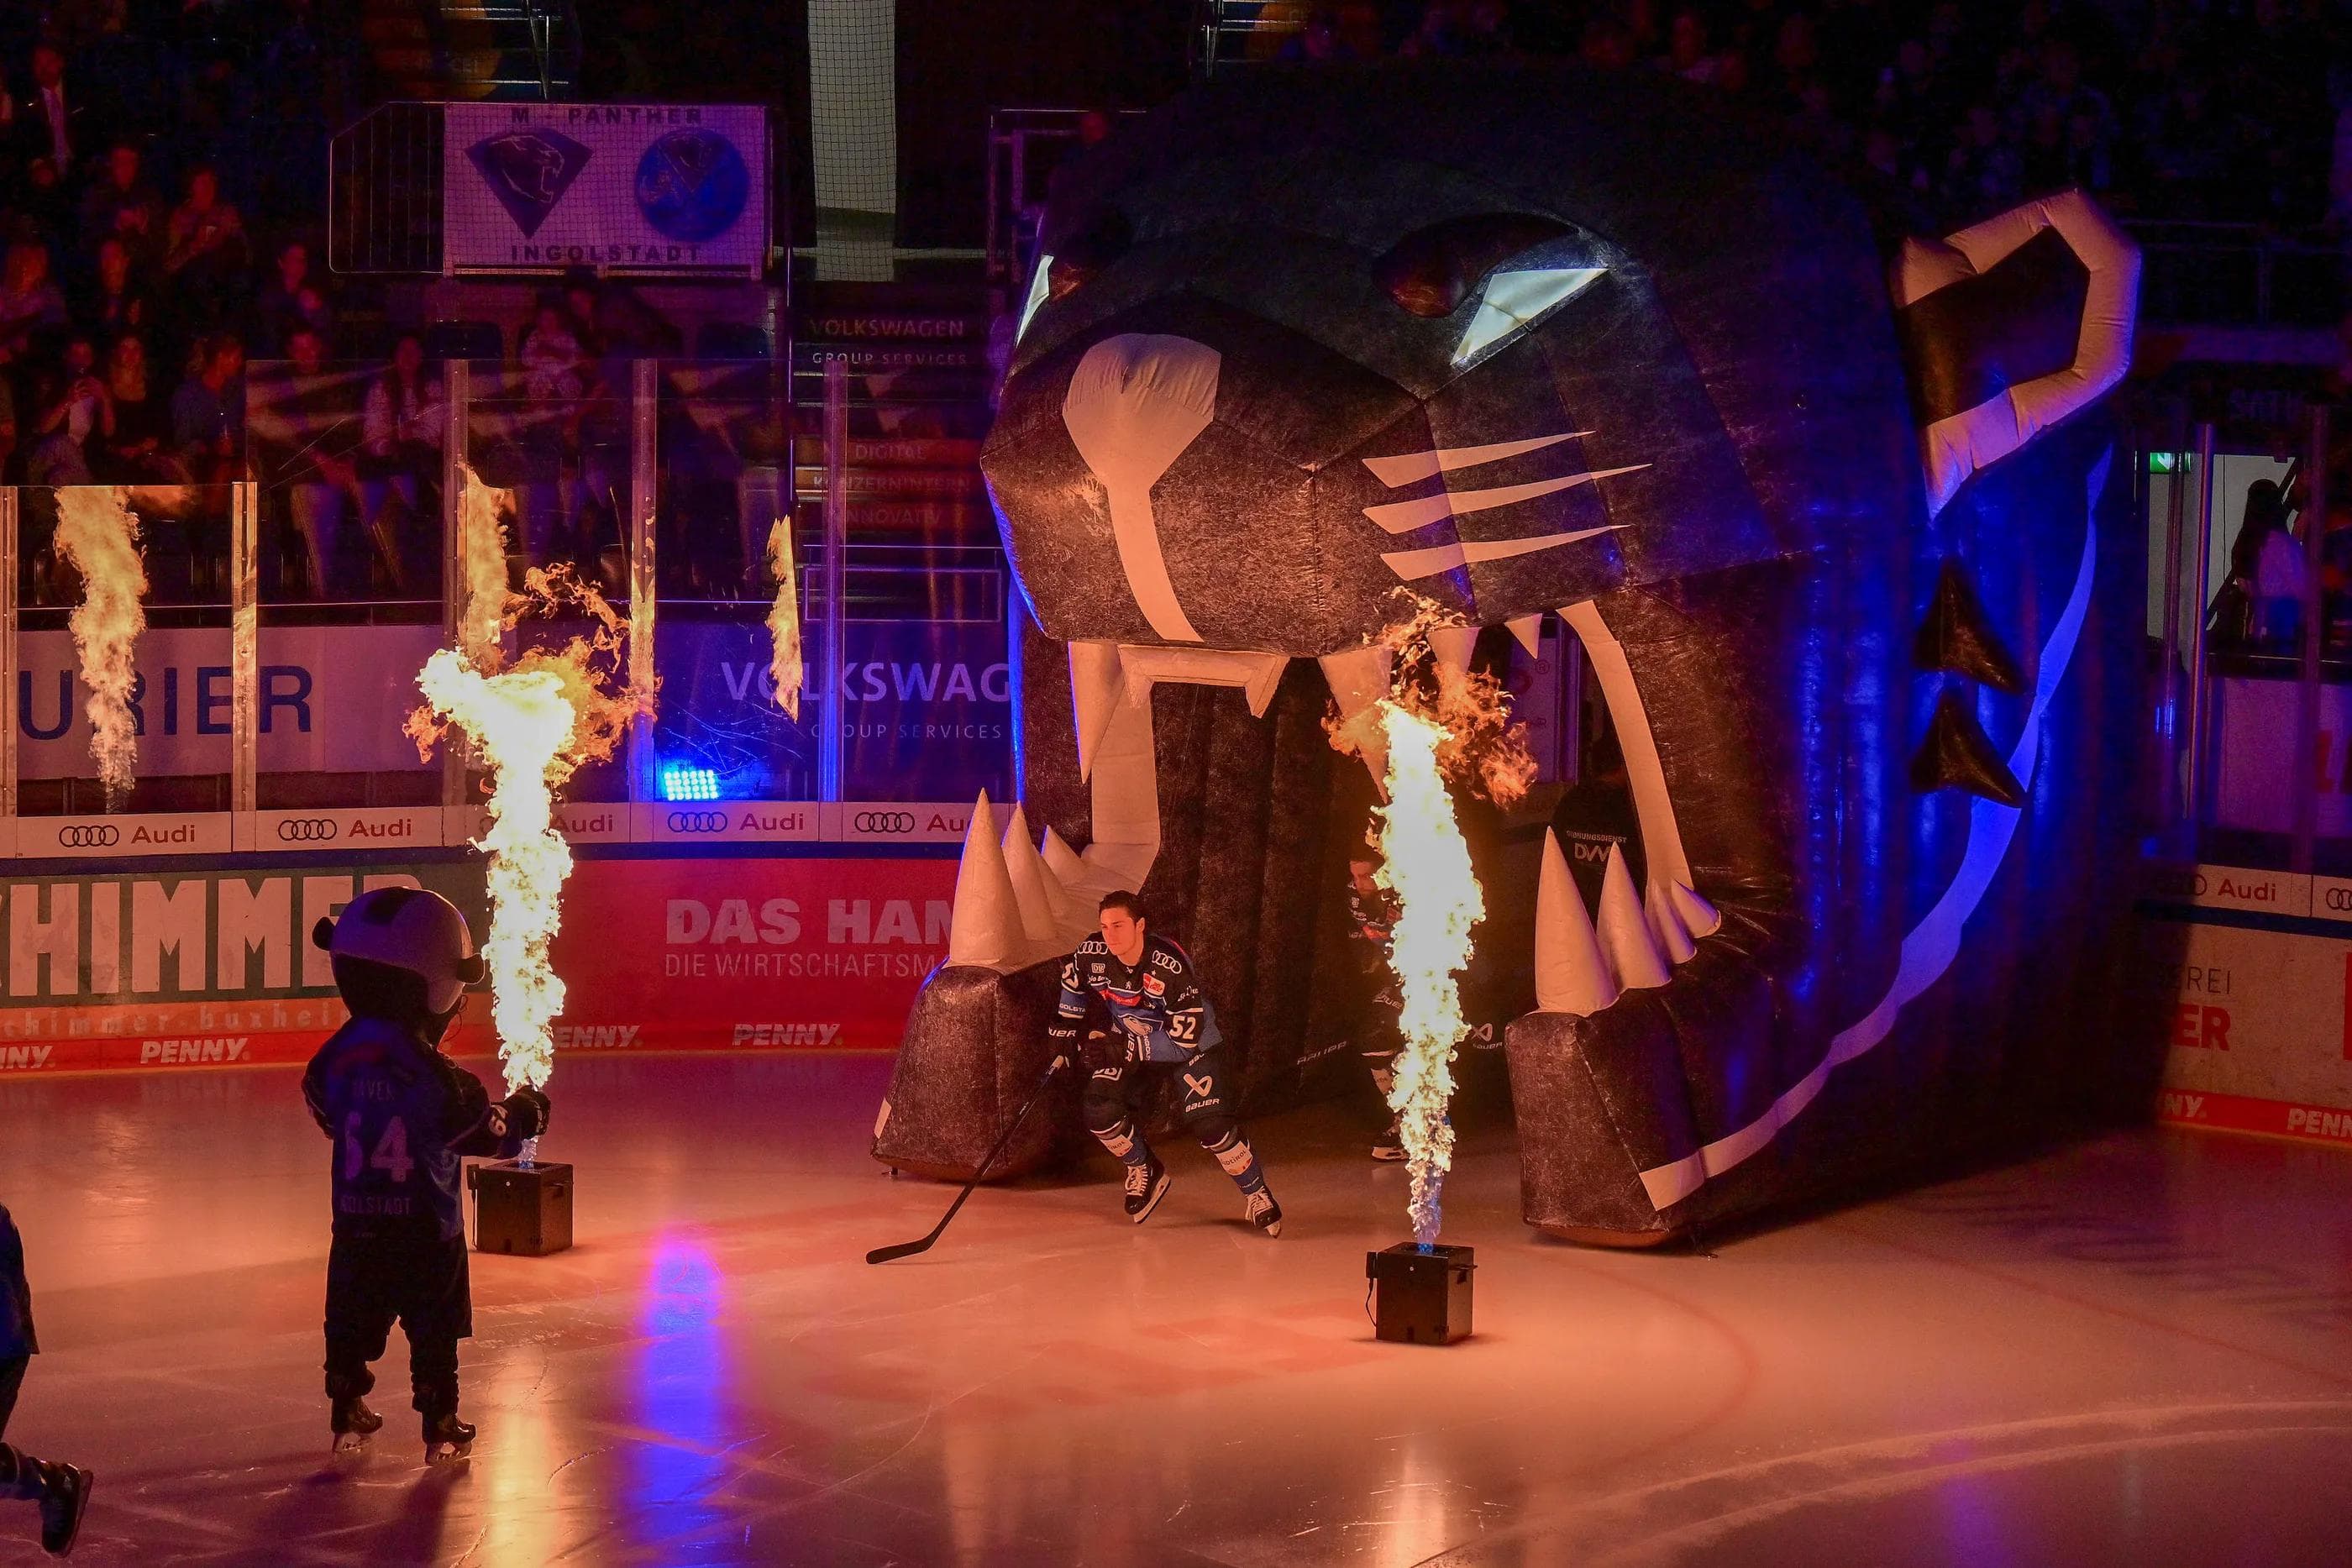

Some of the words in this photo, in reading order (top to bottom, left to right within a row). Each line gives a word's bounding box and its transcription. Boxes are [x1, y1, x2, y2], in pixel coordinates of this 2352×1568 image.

[511, 108, 530, 124] M
[568, 108, 702, 125] PANTHER
[511, 245, 699, 262] INGOLSTADT
[809, 318, 964, 337] VOLKSWAGEN
[899, 724, 1002, 738] SERVICES
[348, 818, 412, 838] Audi
[739, 812, 804, 831] Audi
[927, 814, 970, 832] Au
[131, 825, 196, 845] Audi
[2217, 879, 2276, 901] Audi
[666, 899, 801, 945] DAS
[0, 874, 421, 997] HIMME
[665, 953, 706, 978] DIE
[1169, 1015, 1196, 1040] 52
